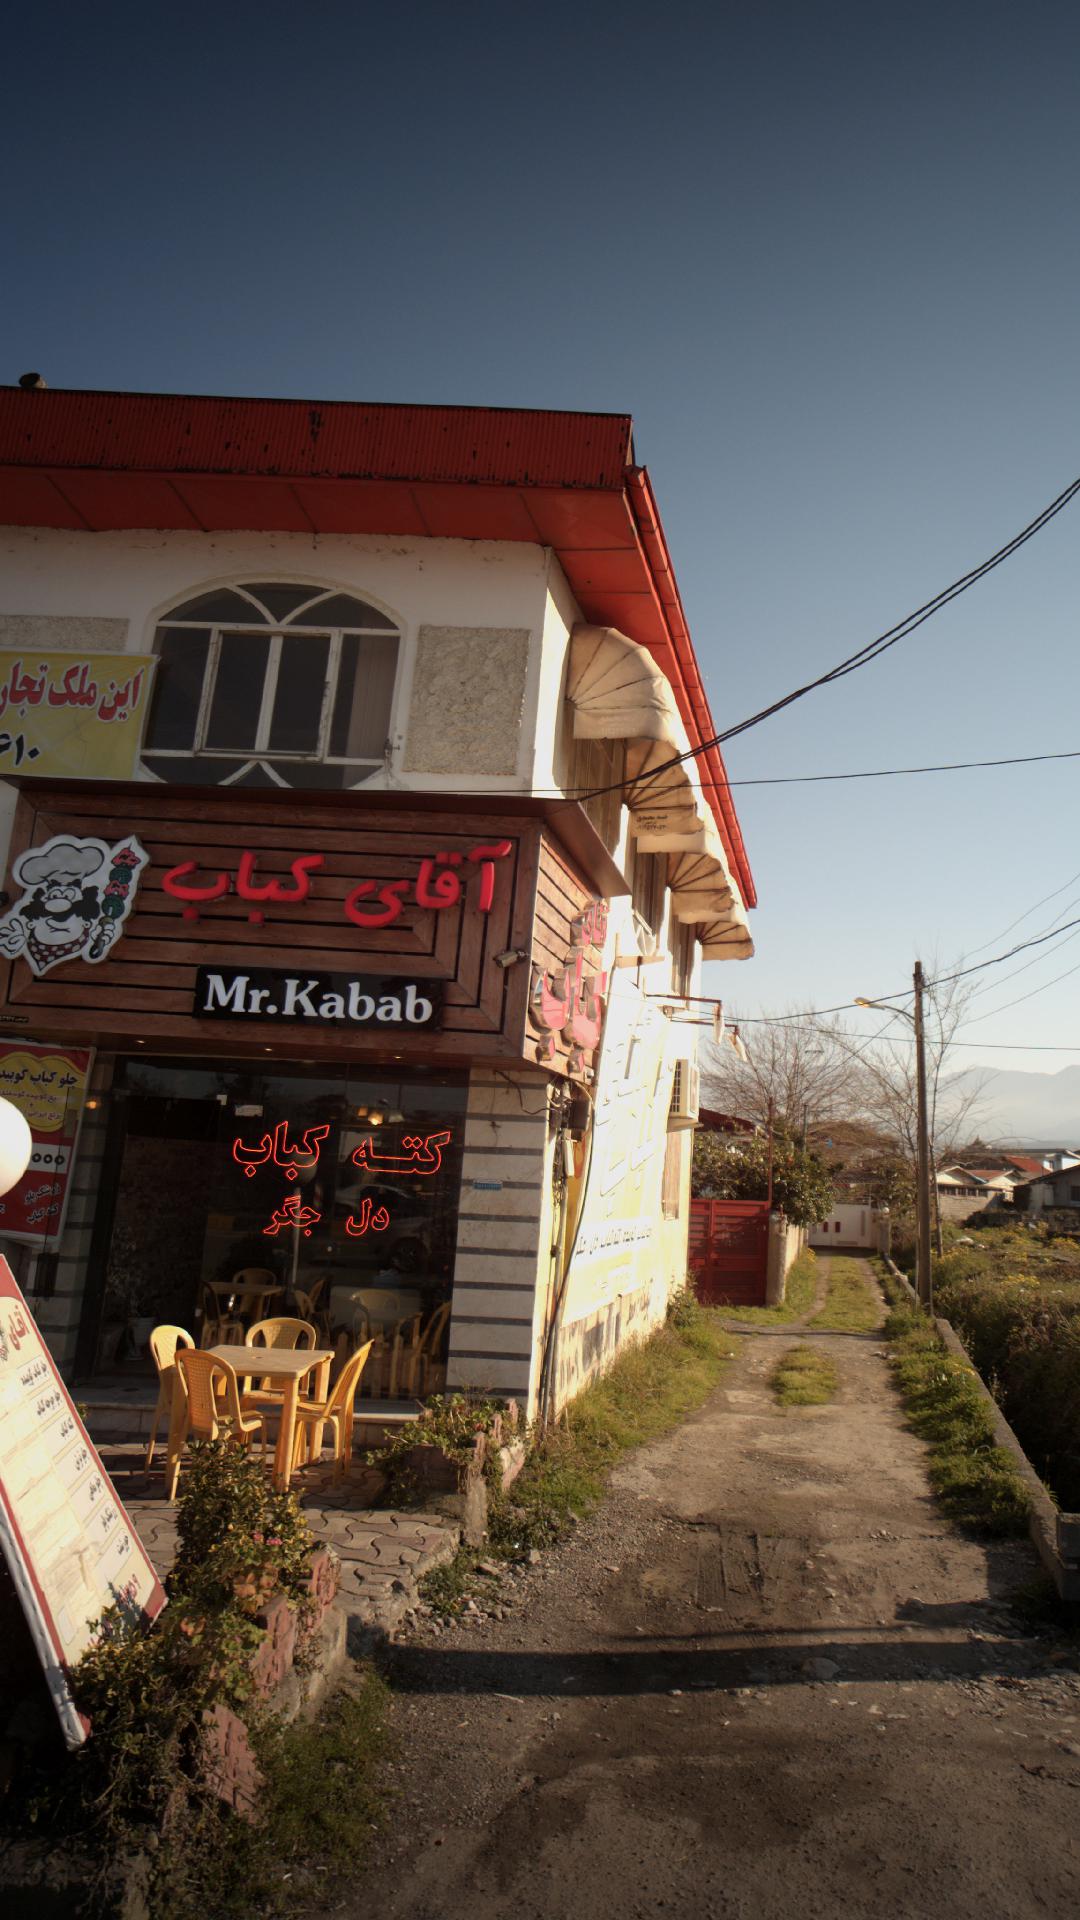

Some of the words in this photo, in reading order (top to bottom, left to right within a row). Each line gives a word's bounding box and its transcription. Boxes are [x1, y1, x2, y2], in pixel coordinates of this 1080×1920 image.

[48, 664, 96, 706] ملک
[98, 667, 144, 720] این
[162, 852, 325, 925] کباب
[344, 841, 512, 928] آقای
[203, 974, 433, 1024] Mr.Kabab
[30, 1071, 57, 1087] کباب
[233, 1120, 330, 1181] کباب
[352, 1131, 451, 1175] کته
[263, 1195, 322, 1237] جگر
[346, 1198, 390, 1236] دل
